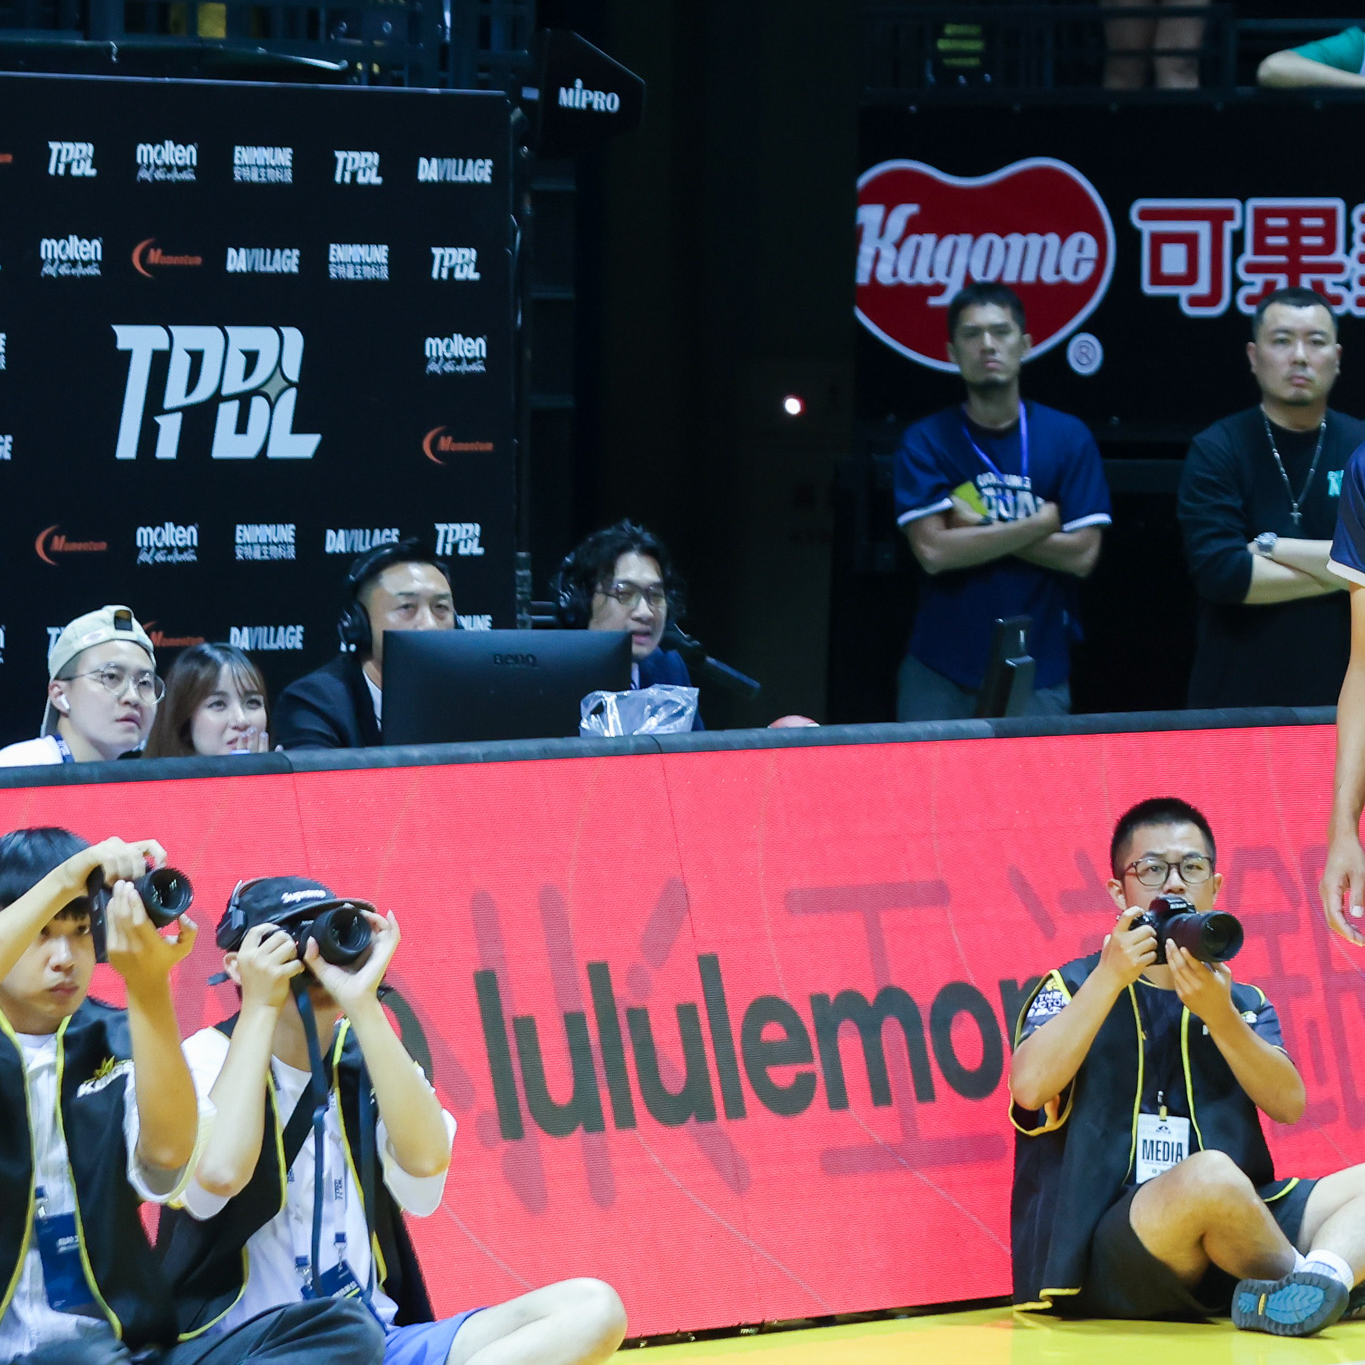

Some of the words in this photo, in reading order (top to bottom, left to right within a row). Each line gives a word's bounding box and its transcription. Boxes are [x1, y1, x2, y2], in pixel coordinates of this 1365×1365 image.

[48, 141, 97, 176] TPBL
[136, 140, 197, 166] molten
[334, 150, 382, 184] TPBL
[417, 156, 493, 183] DAVILLAGE
[40, 235, 102, 261] molten
[226, 247, 299, 274] DAVILLAGE
[855, 203, 1098, 307] Kagome
[431, 247, 481, 281] TPBL
[425, 333, 487, 358] molten
[111, 325, 321, 458] TPBL
[136, 522, 198, 548] molten
[434, 523, 485, 555] TPBL
[230, 625, 304, 650] DAVILLAGE
[1141, 1138, 1184, 1162] MEDIA
